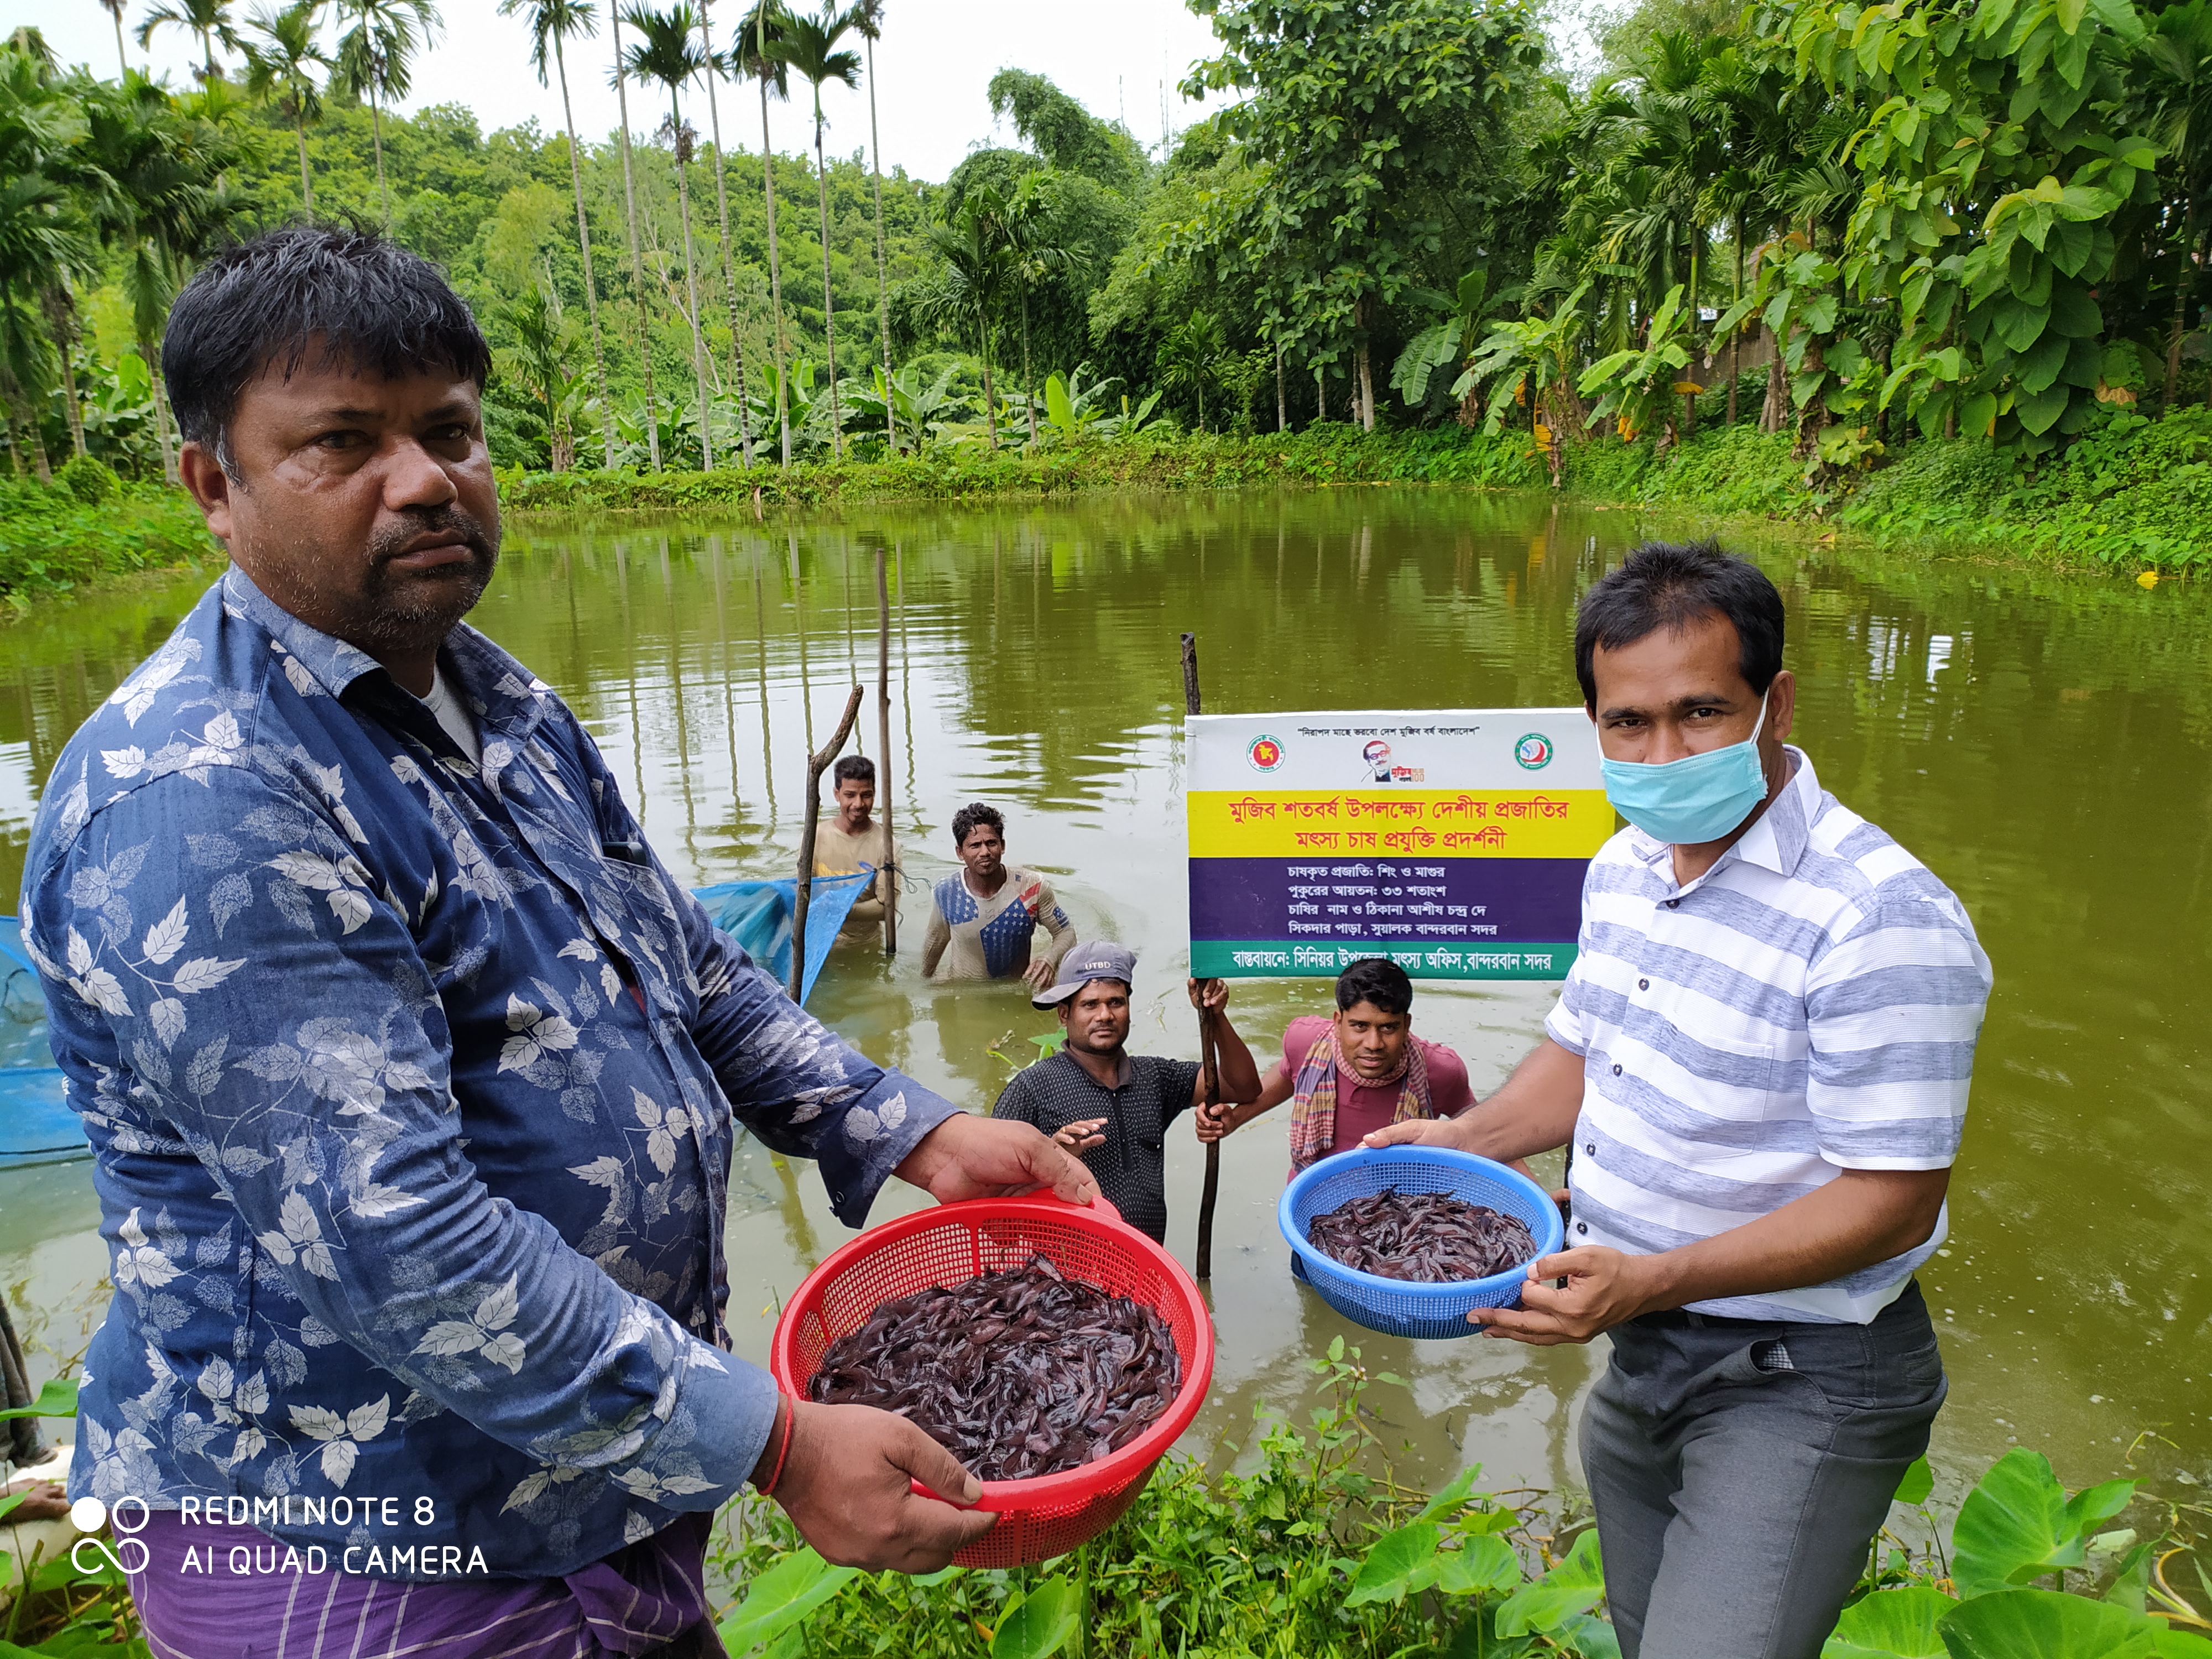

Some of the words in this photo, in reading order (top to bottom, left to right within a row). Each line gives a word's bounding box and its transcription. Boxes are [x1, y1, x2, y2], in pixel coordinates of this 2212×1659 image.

[1228, 796, 1277, 824] মুজিব
[1282, 795, 1340, 820] শতবর্ষ
[1344, 796, 1426, 820] উপলক্ষ্যে
[1432, 795, 1489, 820] দেশীয়
[1494, 795, 1570, 820] প্রজাতির
[1294, 831, 1341, 849] মৎস্য
[1345, 831, 1379, 849] চাষ
[1384, 826, 1437, 854] প্রযুক্তি
[1442, 826, 1508, 850] প্রদর্শনী
[1287, 866, 1329, 881] চাষকৃত
[1376, 863, 1397, 878] শিং
[1400, 867, 1411, 877] ও
[1414, 867, 1446, 878] মাগুর
[1288, 885, 1329, 899] পুকুরের
[1381, 886, 1402, 896] ৩৩
[1406, 885, 1447, 898] শতাংশ
[1287, 901, 1319, 915] চাষির
[1326, 904, 1348, 915] নাম
[1352, 905, 1362, 915] ও
[1365, 901, 1404, 915] ঠিকানা
[1447, 905, 1468, 917] চন্দ্র
[1471, 906, 1487, 916] দে
[1287, 920, 1332, 933] সিকদার
[1370, 923, 1412, 937] সুয়ালক
[1415, 924, 1468, 935] বান্দরবান
[1470, 925, 1498, 935] সদর
[1085, 961, 1110, 970] UTBD
[1292, 946, 1334, 968] সিনিয়র
[1390, 952, 1422, 969] মৎস্য
[1523, 953, 1552, 970] সদর
